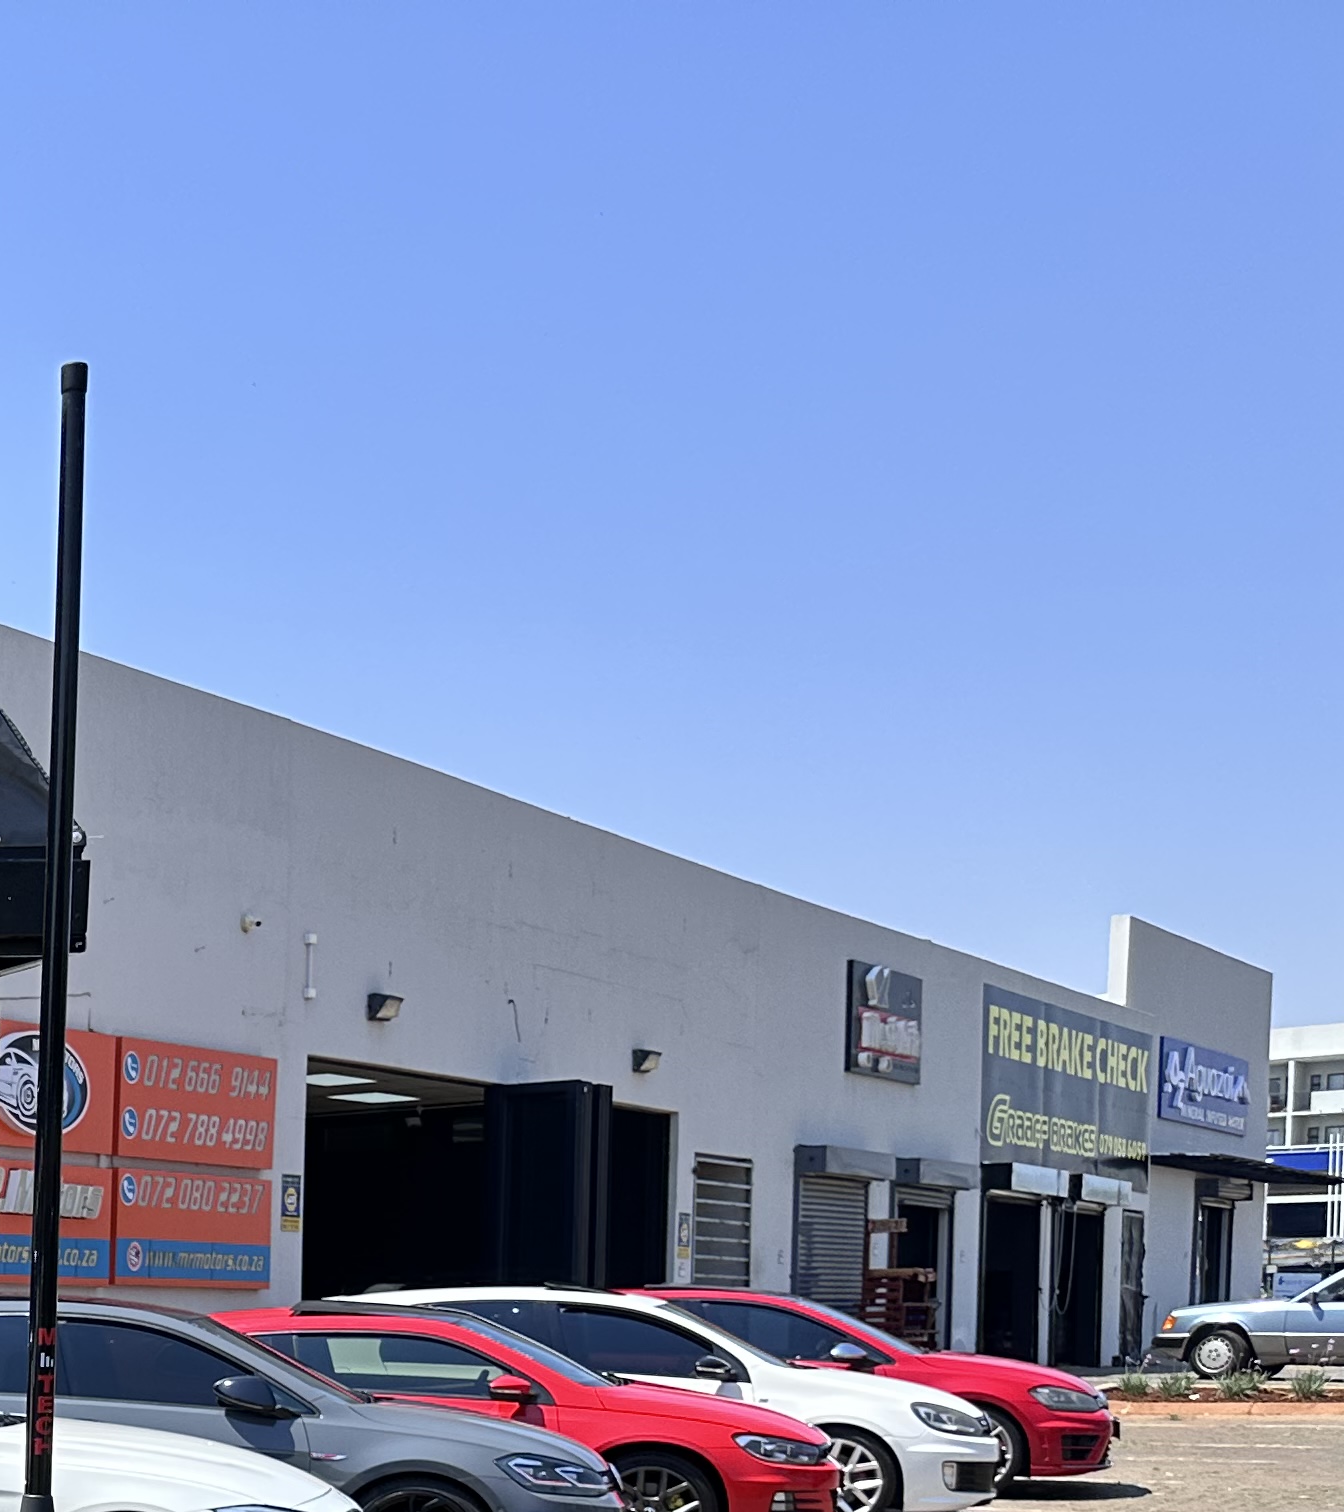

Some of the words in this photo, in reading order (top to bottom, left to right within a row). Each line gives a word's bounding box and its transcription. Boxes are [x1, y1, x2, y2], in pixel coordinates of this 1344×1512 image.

[988, 1004, 1034, 1065] FREE
[1036, 1019, 1094, 1080] BRAKE
[1095, 1037, 1149, 1094] CHECK
[143, 1055, 183, 1091] 012
[184, 1060, 223, 1094] 666
[229, 1067, 272, 1100] 9144
[141, 1108, 181, 1143] 072
[183, 1113, 220, 1147] 788
[221, 1118, 269, 1151] 4998
[137, 1175, 177, 1208] 072
[178, 1179, 215, 1211] 080
[216, 1182, 265, 1214] 2237
